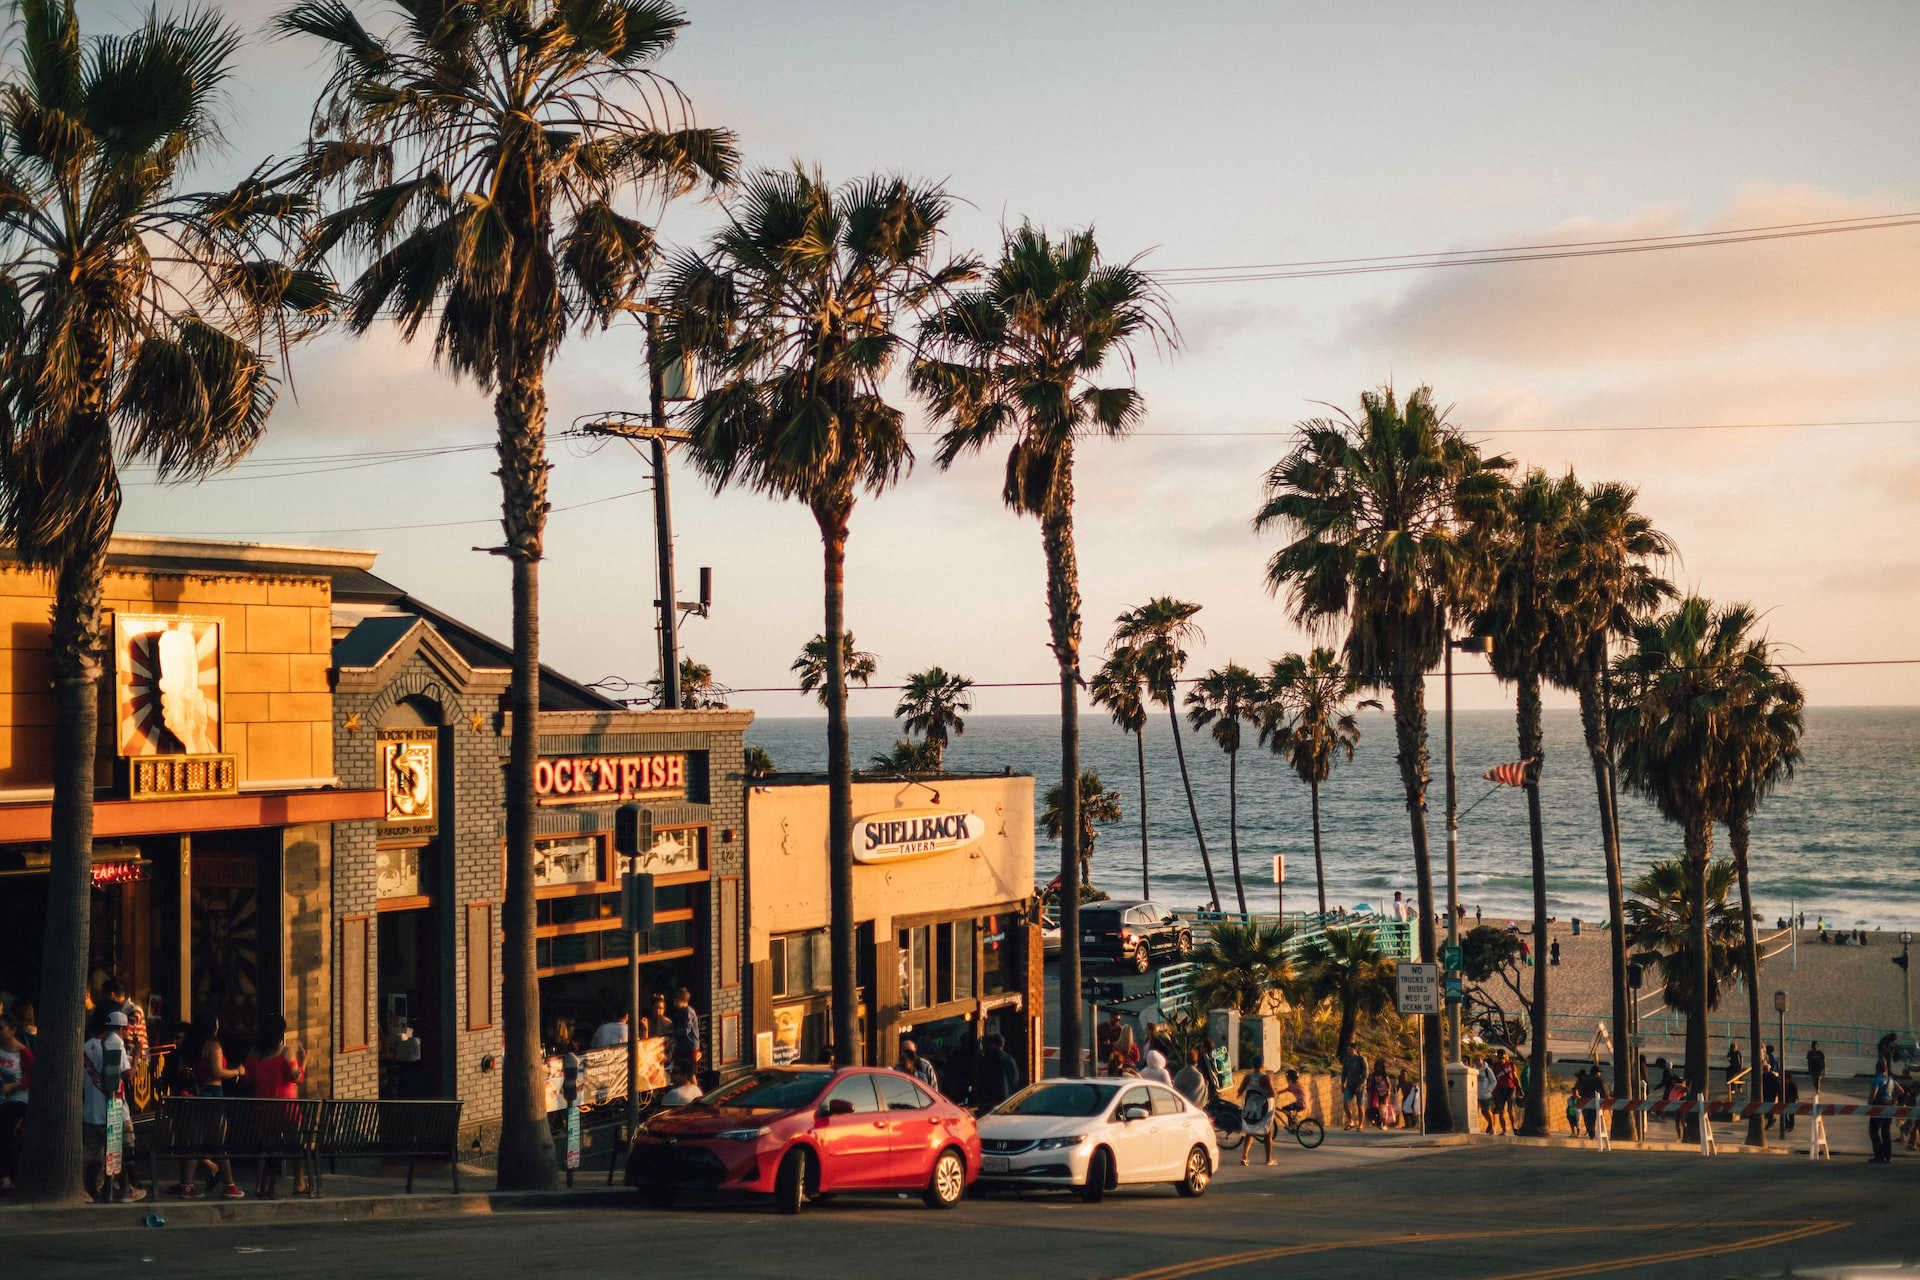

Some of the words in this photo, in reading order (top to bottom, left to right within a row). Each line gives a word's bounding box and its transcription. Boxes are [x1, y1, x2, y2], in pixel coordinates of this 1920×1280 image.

[416, 729, 437, 740] FISH
[139, 759, 234, 793] BREWCO
[534, 756, 619, 795] OCK'N
[620, 754, 685, 799] FISH
[865, 814, 969, 850] SHELLBACK
[900, 841, 936, 855] TAVERN
[1411, 966, 1423, 975] NO
[1401, 976, 1424, 984] TRUCKS
[1426, 976, 1435, 984] OR
[1405, 994, 1421, 1002] WEST
[1423, 994, 1431, 1002] OF
